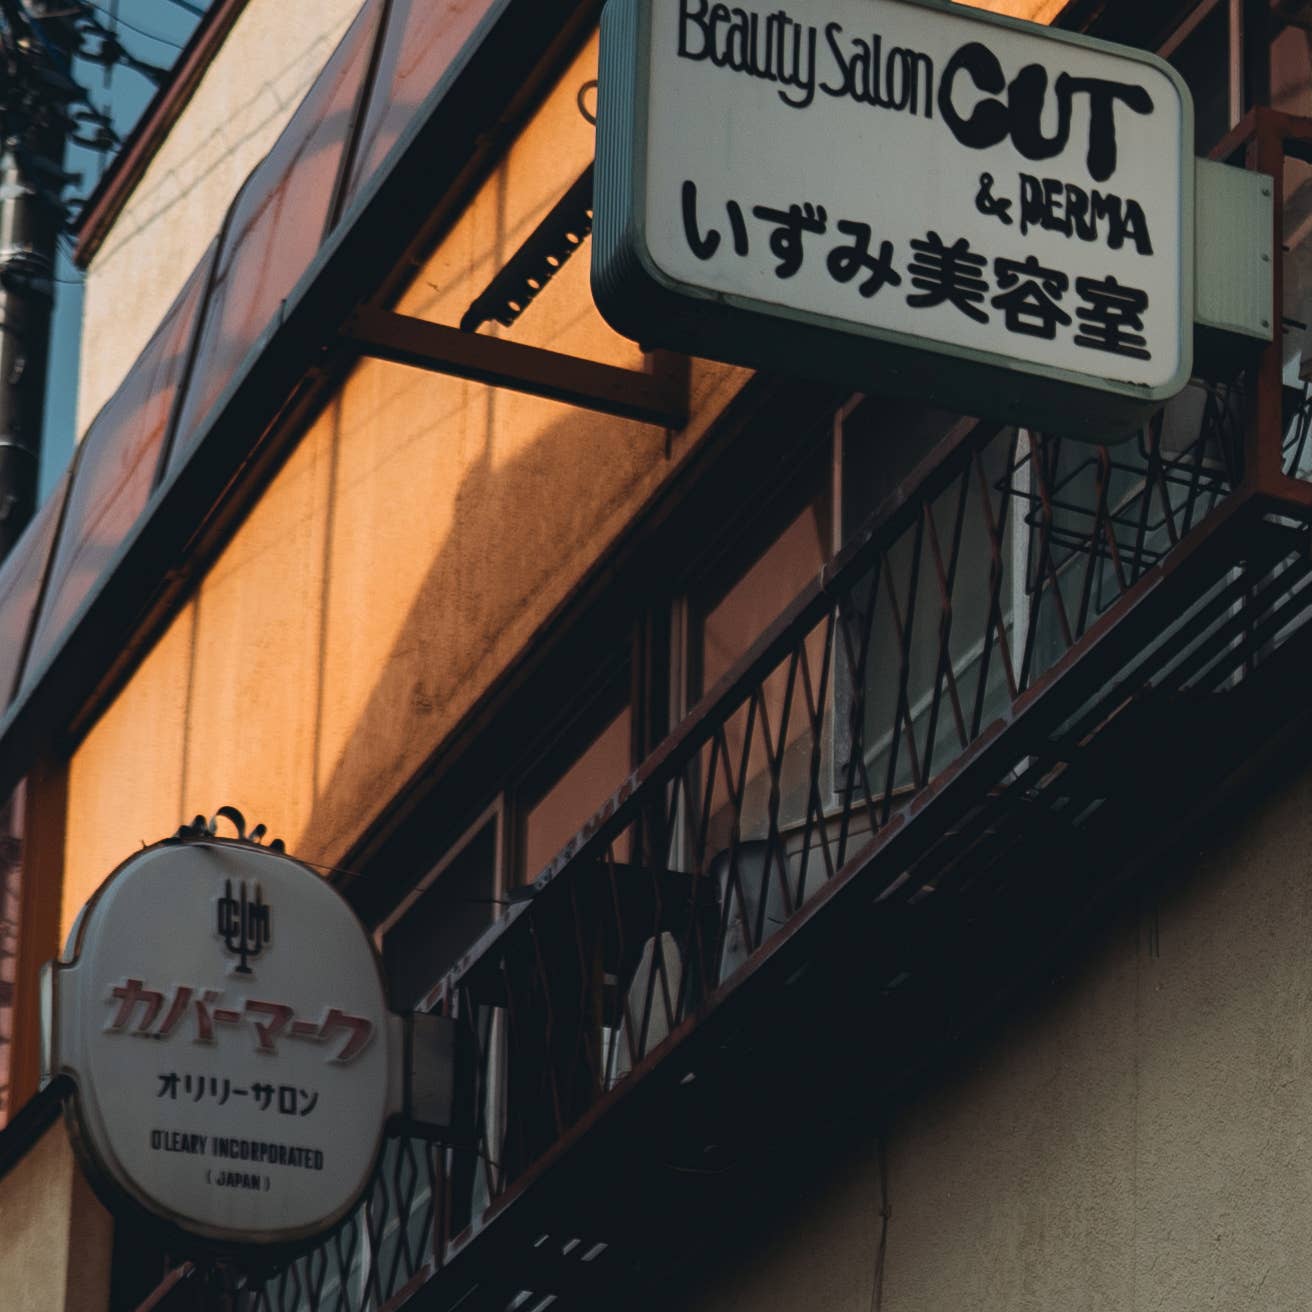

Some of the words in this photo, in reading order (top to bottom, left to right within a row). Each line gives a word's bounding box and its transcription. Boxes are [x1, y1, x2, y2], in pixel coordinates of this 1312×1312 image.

[678, 0, 817, 109] Beauty
[820, 22, 933, 120] Salon
[938, 41, 1154, 182] CUT
[975, 172, 1013, 226] &
[1019, 172, 1154, 257] DERMA
[681, 179, 1152, 362] いずみ美容室
[109, 977, 373, 1063] カバーマーク
[156, 1071, 319, 1117] オリリーサロン
[150, 1128, 207, 1157] O'LEARY
[211, 1134, 324, 1172] INCORPORATED
